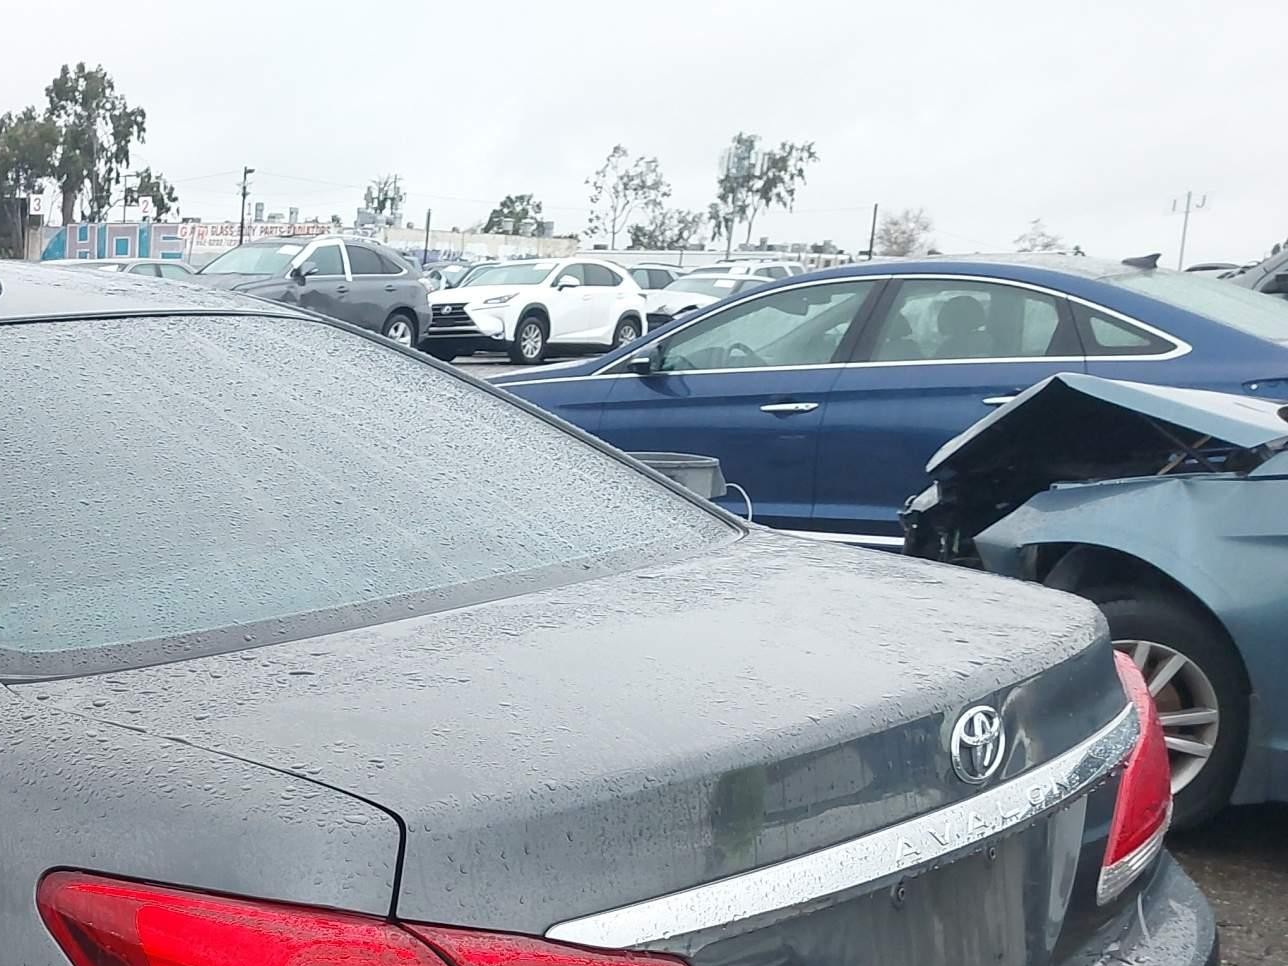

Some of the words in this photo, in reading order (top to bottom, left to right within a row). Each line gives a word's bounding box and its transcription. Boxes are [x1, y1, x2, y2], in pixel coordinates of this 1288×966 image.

[33, 197, 41, 212] 3
[142, 199, 150, 214] 2
[894, 772, 1072, 863] AVALON
